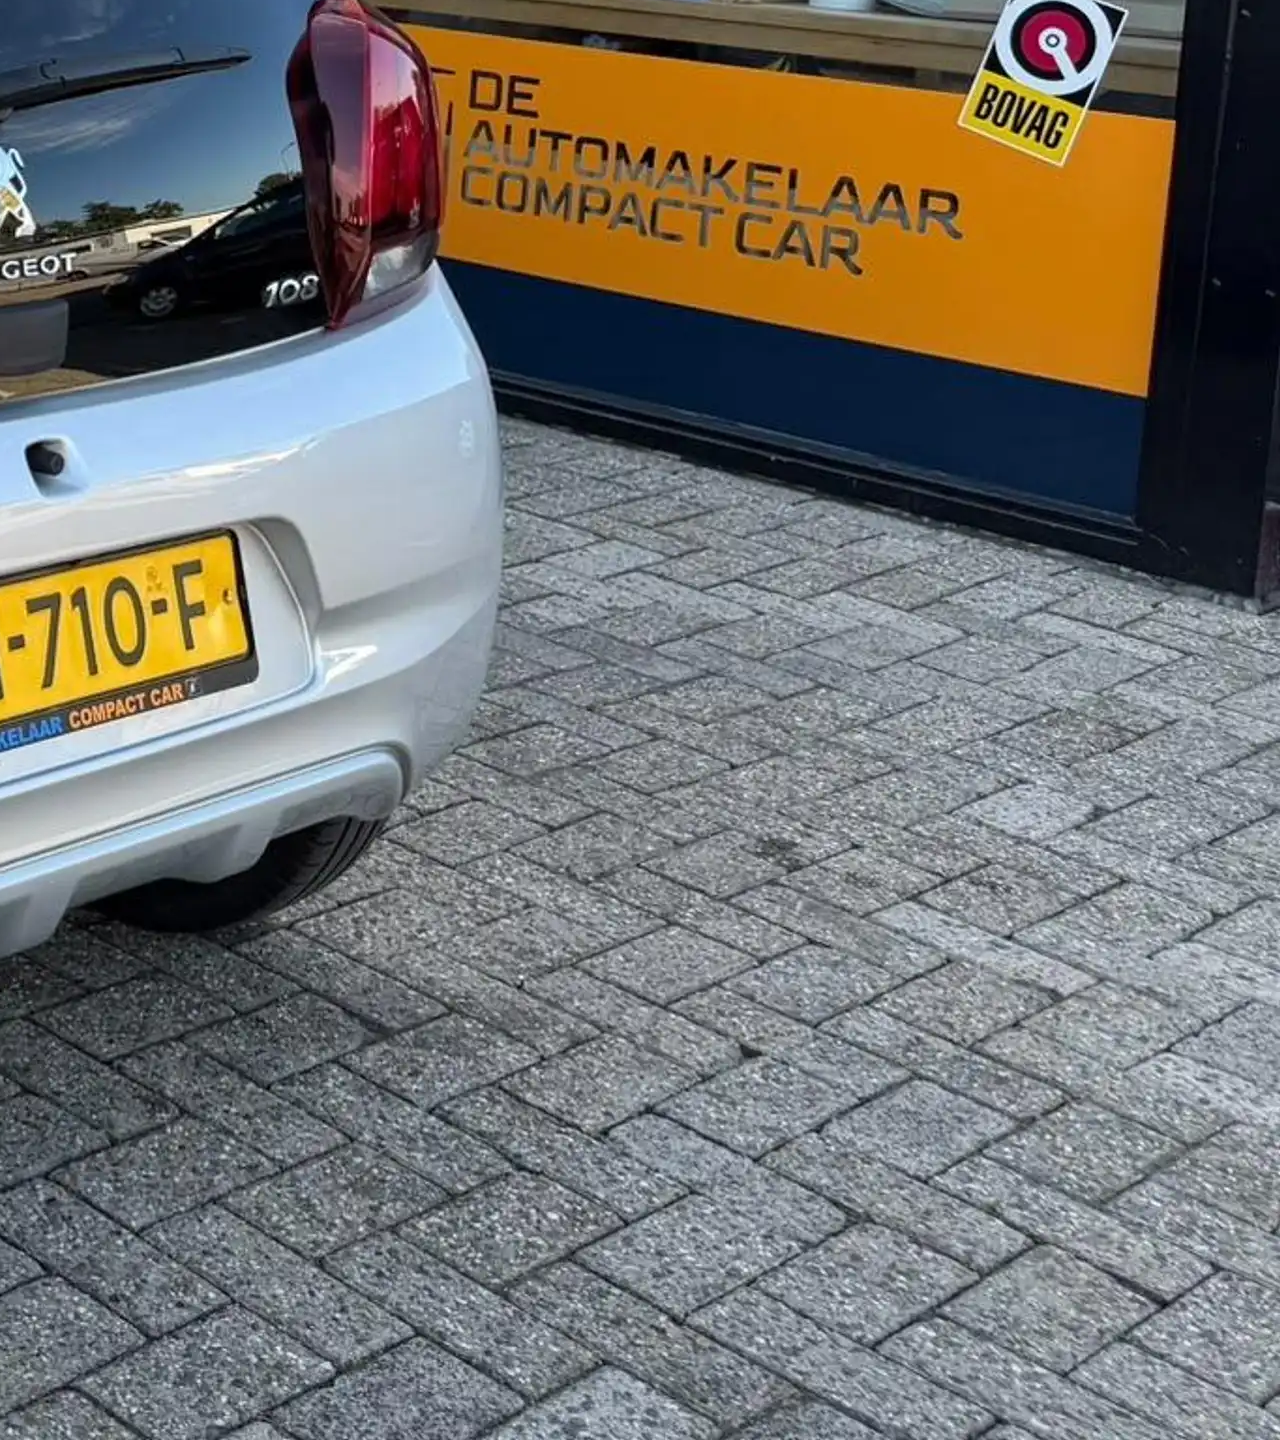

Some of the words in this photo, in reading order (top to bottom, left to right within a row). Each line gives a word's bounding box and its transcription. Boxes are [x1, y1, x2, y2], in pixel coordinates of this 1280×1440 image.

[468, 69, 541, 119] DE
[973, 82, 1070, 149] BOVAG
[462, 119, 963, 241] AUTOMAKELAAR
[460, 165, 724, 250] COMPACT
[734, 212, 865, 278] CAR
[264, 272, 321, 309] 108
[68, 689, 147, 729] COMPACT
[149, 682, 185, 707] CAR
